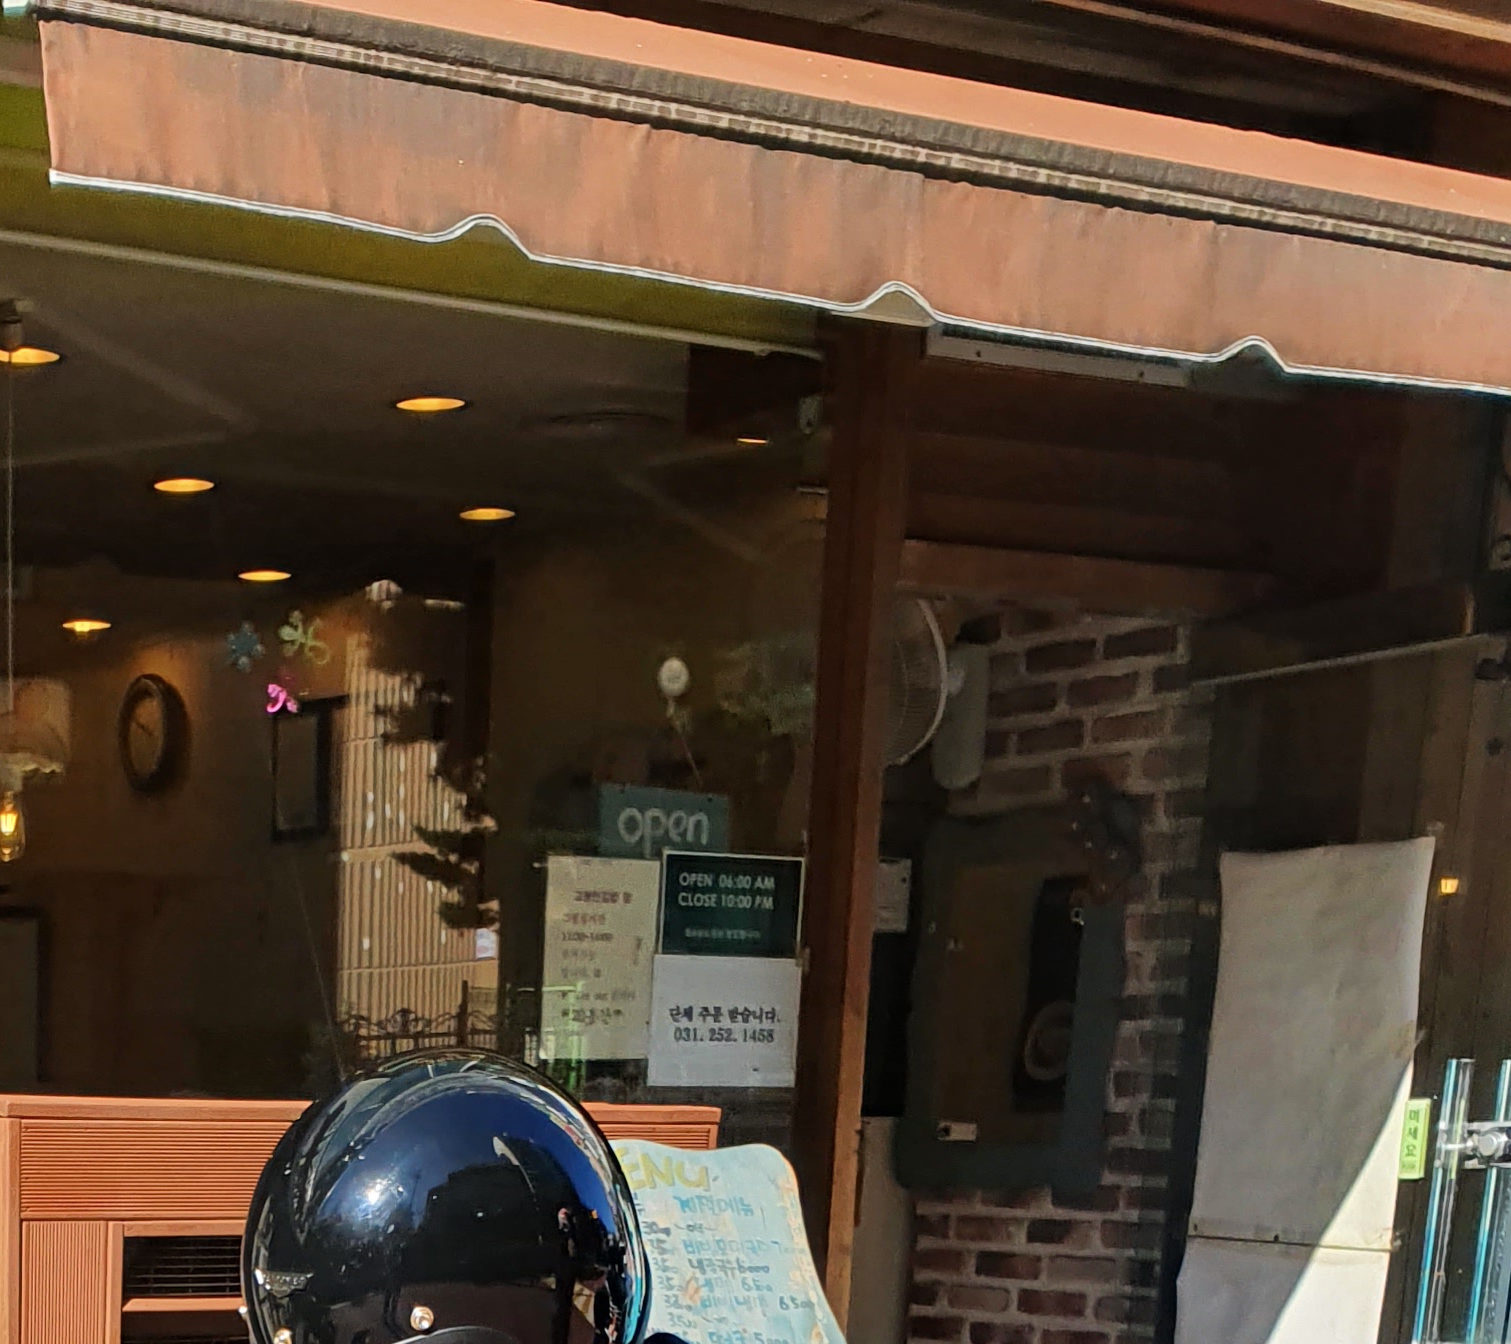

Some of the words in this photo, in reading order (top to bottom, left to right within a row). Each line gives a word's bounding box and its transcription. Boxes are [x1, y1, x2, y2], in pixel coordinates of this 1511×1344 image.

[617, 806, 710, 858] open
[679, 872, 713, 887] OPEN
[754, 875, 776, 890] AM
[678, 892, 718, 908] CLOSE
[754, 895, 774, 910] PM
[616, 1147, 709, 1191] ENU
